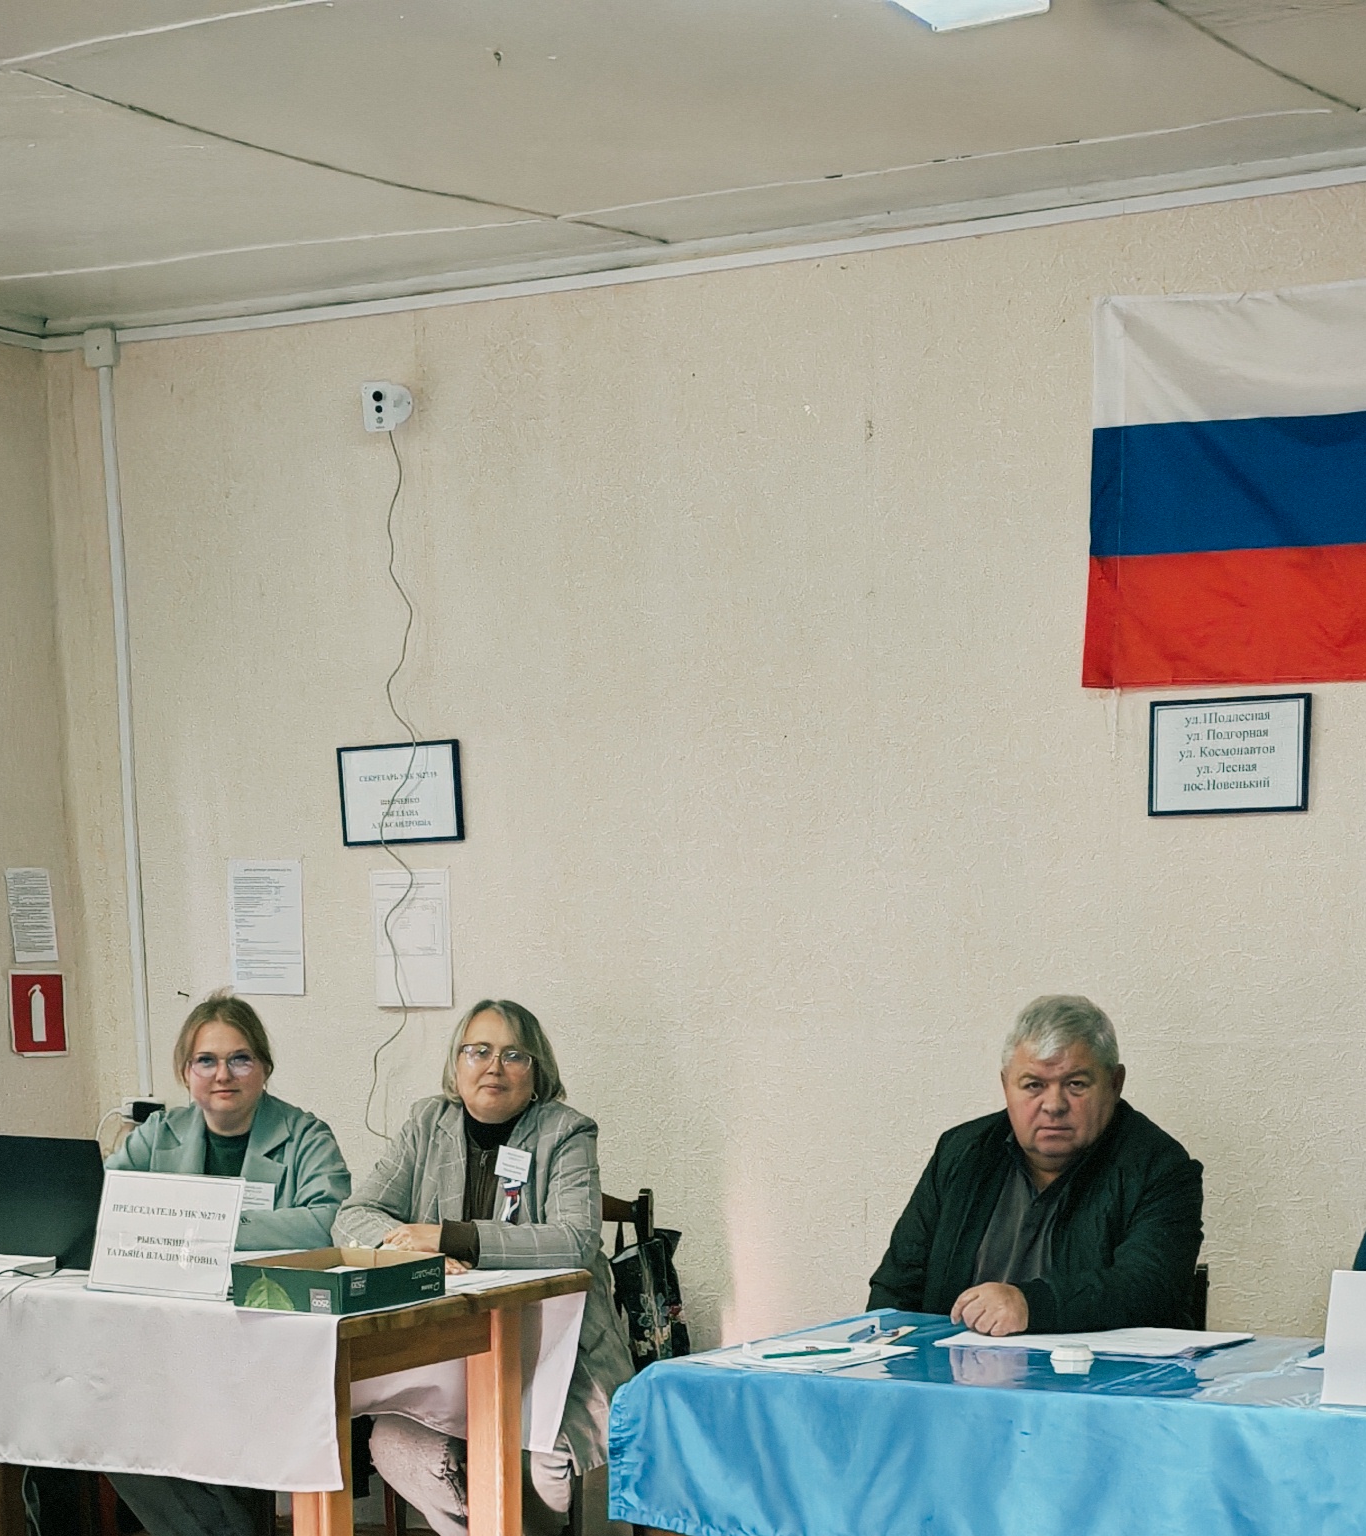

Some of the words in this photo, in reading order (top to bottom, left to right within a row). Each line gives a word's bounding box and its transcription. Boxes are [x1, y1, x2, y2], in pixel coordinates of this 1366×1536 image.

[1186, 733, 1203, 744] ул.
[1207, 728, 1269, 741] Подгорная
[1179, 750, 1196, 762] ул.
[1200, 745, 1276, 758] Космонавтов
[1196, 765, 1213, 777] ул.
[1216, 762, 1258, 773] Лесная
[112, 1203, 177, 1217] ПРЕДСЕДАТЕЛЬ
[179, 1209, 197, 1219] УИК
[107, 1247, 144, 1259] ТАТЬЯНА
